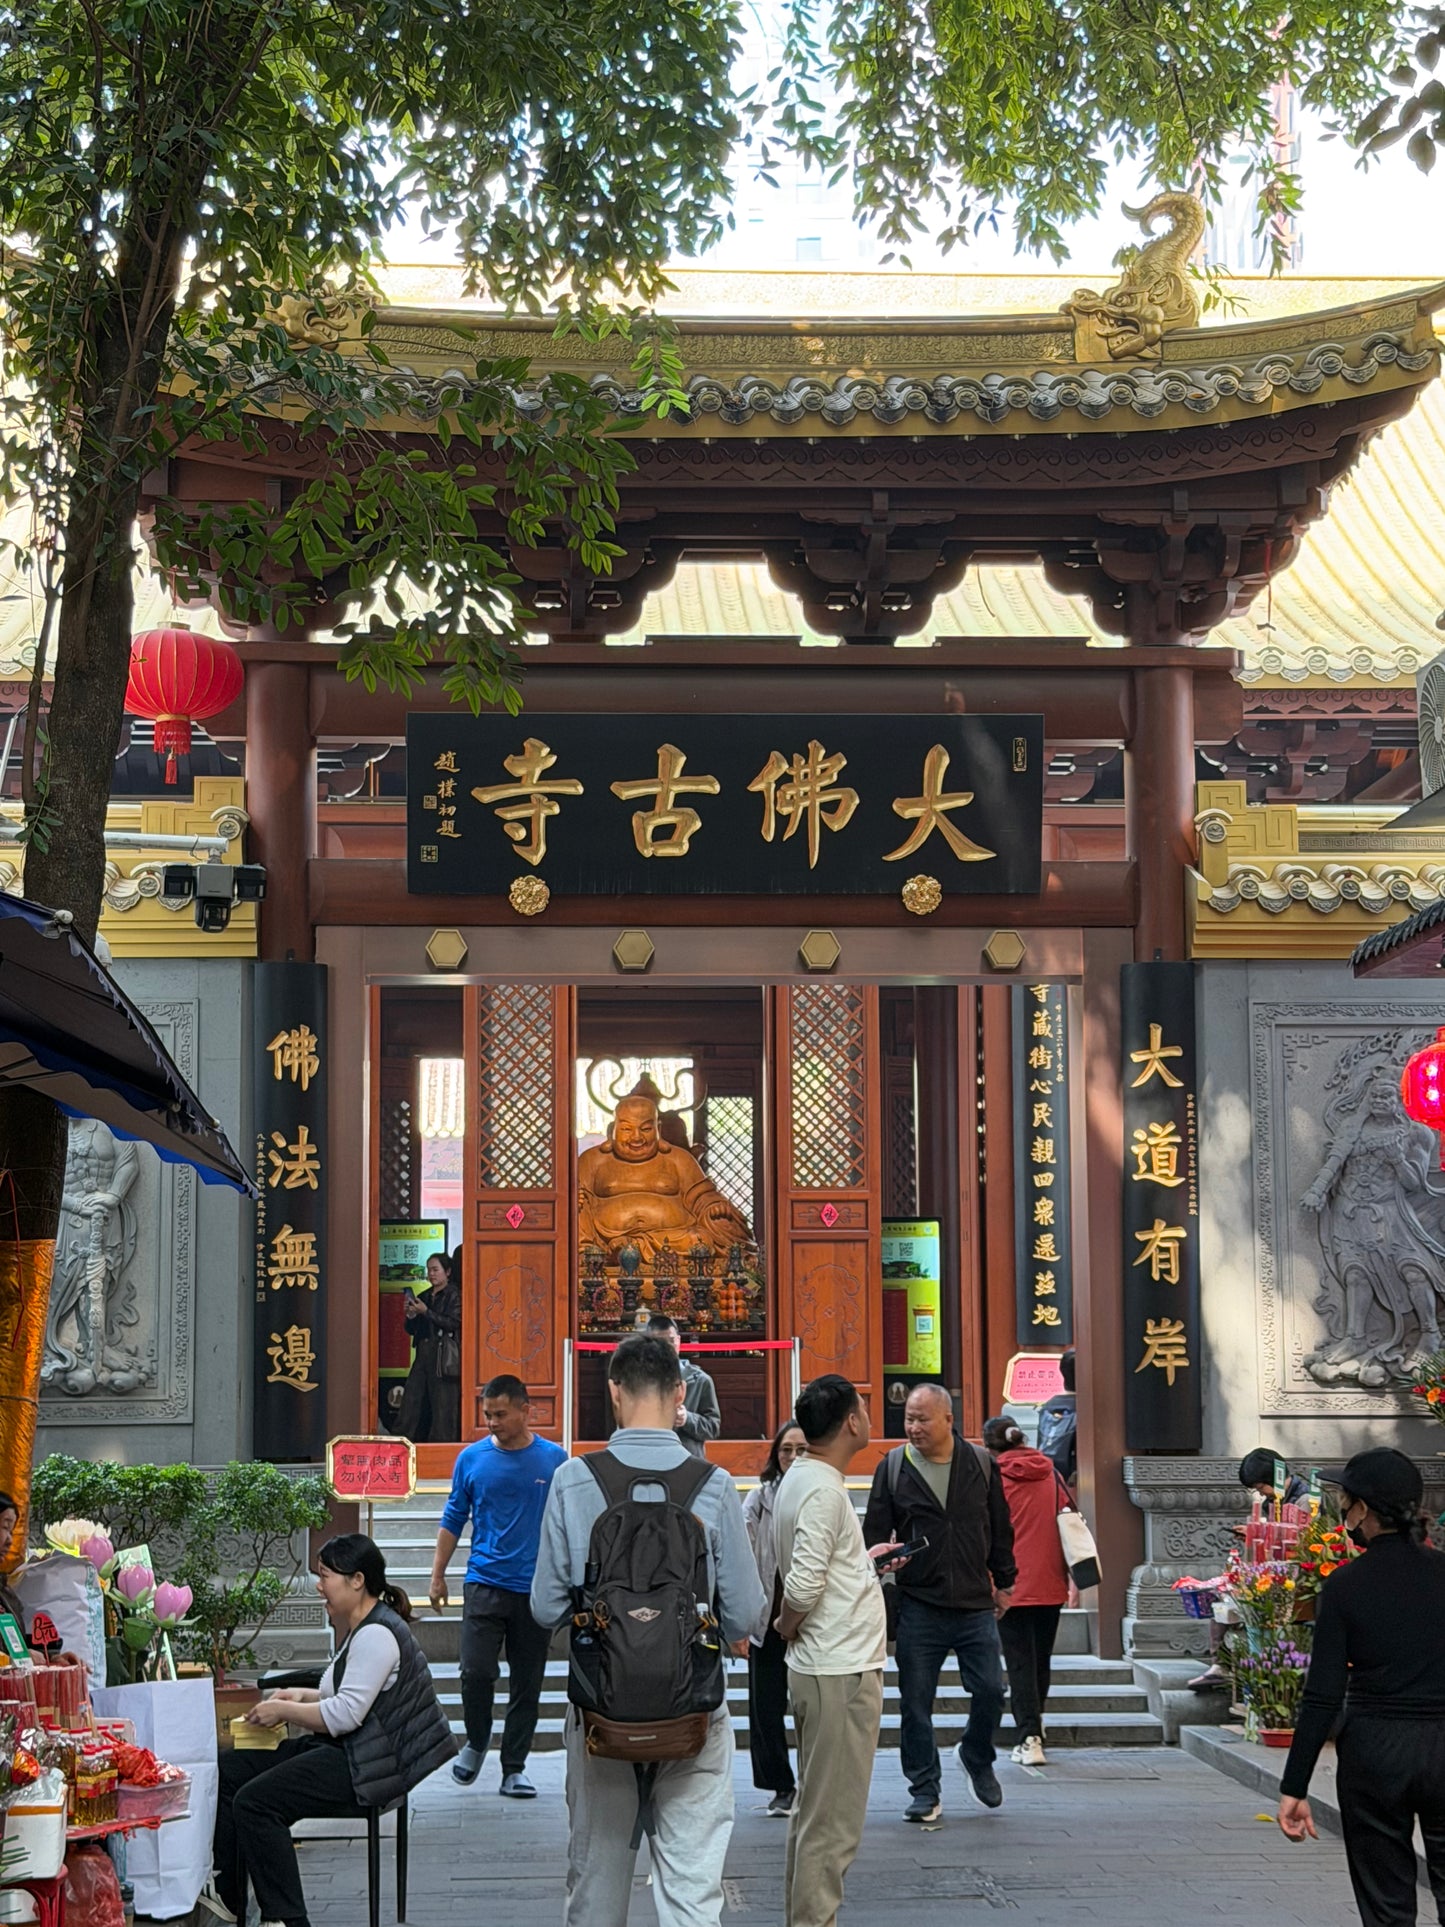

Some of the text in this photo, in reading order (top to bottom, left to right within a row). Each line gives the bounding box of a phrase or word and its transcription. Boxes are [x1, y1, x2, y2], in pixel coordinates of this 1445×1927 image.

[471, 737, 997, 870] 大佛古寺
[266, 1023, 321, 1393] 佛法無邊
[1130, 1022, 1191, 1387] 大道有岸
